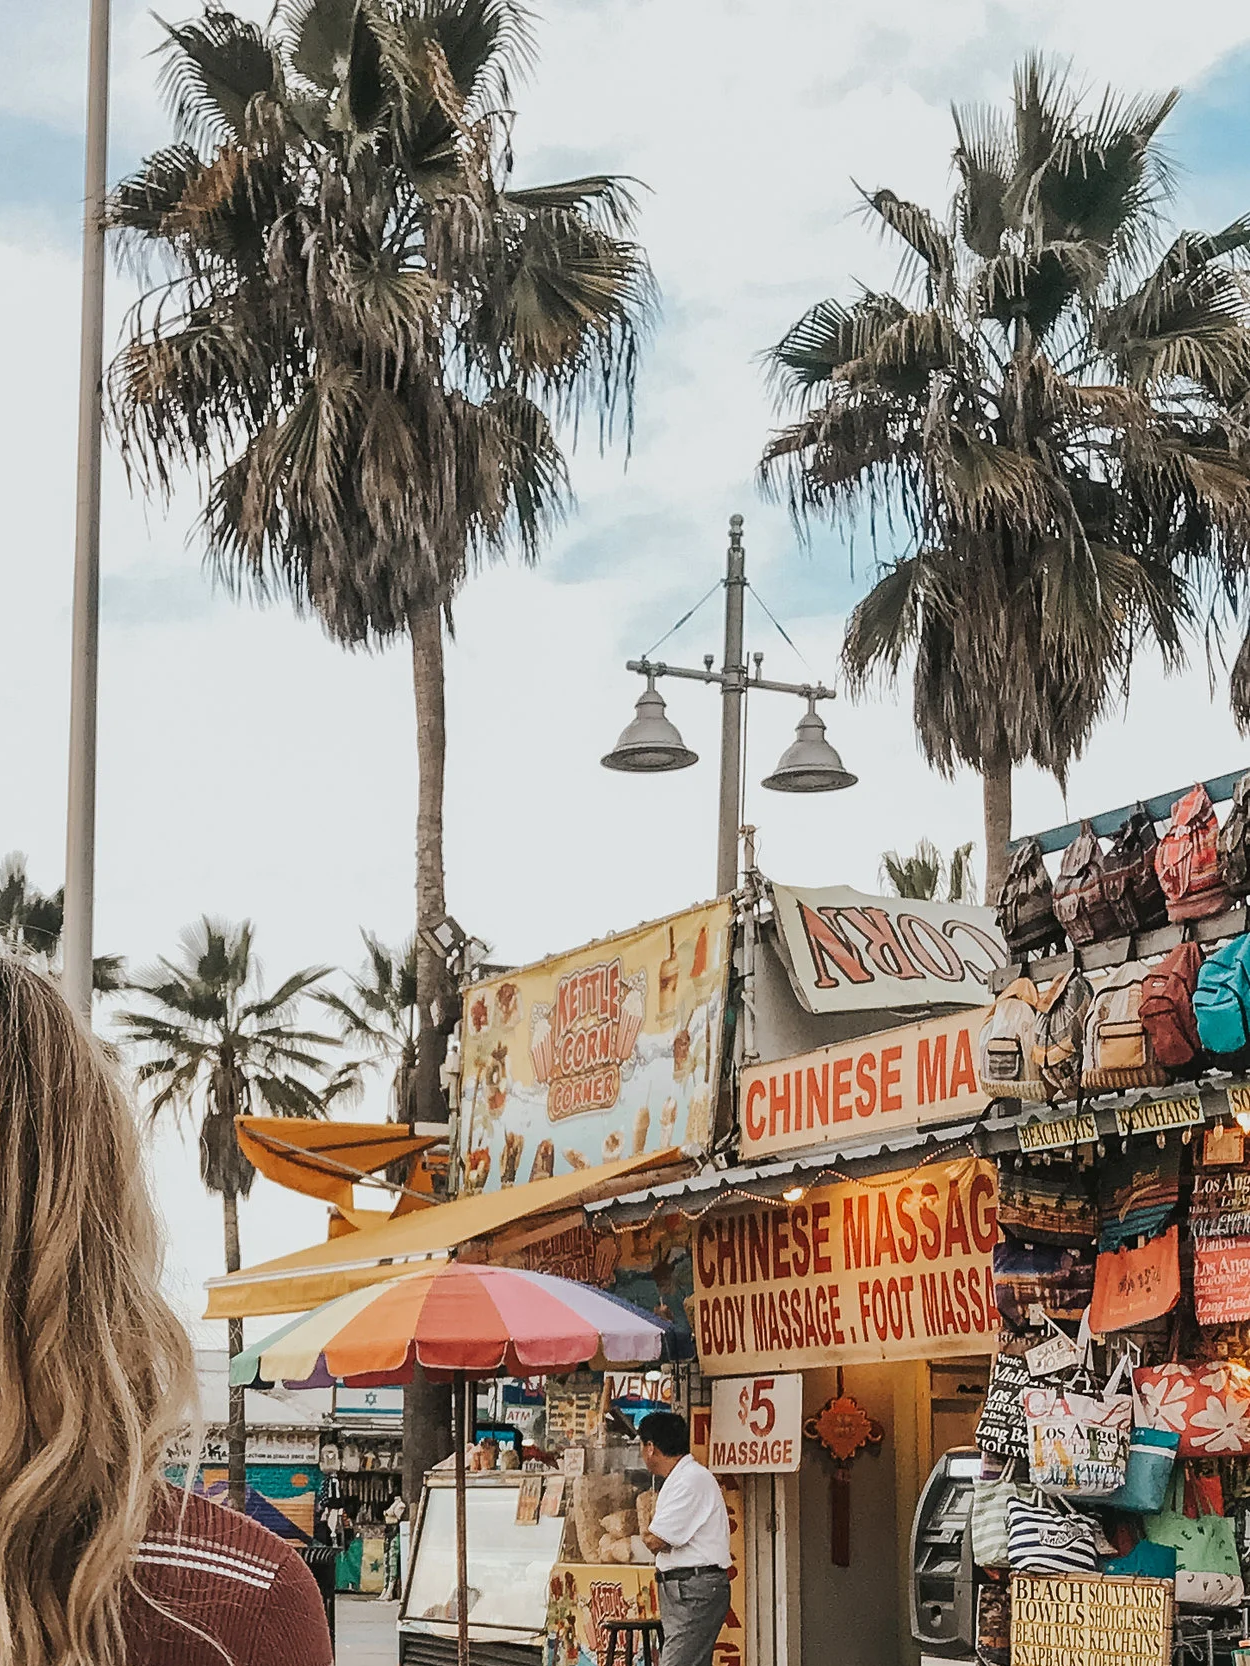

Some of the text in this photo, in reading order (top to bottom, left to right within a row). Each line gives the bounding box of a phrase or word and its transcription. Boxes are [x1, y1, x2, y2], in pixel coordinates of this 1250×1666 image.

[555, 961, 623, 1047] KETTLE
[560, 1021, 613, 1075] CORN
[551, 1071, 616, 1115] CORNER
[745, 1028, 978, 1141] CHINESE MA
[1231, 1088, 1250, 1113] SO
[1118, 1096, 1200, 1133] KEYCHAINS
[1020, 1121, 1061, 1149] BEACH
[1221, 1172, 1250, 1194] Ang
[697, 1173, 999, 1289] CHINESE MASSAG
[1219, 1256, 1250, 1277] Ang
[700, 1293, 746, 1357] BODY
[751, 1284, 843, 1353] MASSAGE
[858, 1275, 915, 1343] FOOT
[920, 1265, 1000, 1337] MASSA
[1226, 1294, 1250, 1311] Beac
[997, 1353, 1022, 1368] Venic
[1036, 1340, 1064, 1362] SALE
[610, 1374, 672, 1401] VENIC
[994, 1365, 1030, 1386] Malib
[507, 1411, 533, 1422] ATM
[738, 1379, 776, 1438] $5
[985, 1402, 1026, 1418] ALIFORN
[1024, 1391, 1075, 1418] CA
[976, 1420, 1010, 1443] Long
[1071, 1423, 1120, 1447] Angel
[713, 1440, 793, 1466] MASSAGE
[1015, 1579, 1162, 1610] BEACH SOUVENIRS
[1015, 1600, 1161, 1633] TOWELS SHOTGLASSES
[1014, 1623, 1160, 1657] BEACH MATS KEYCHAINS
